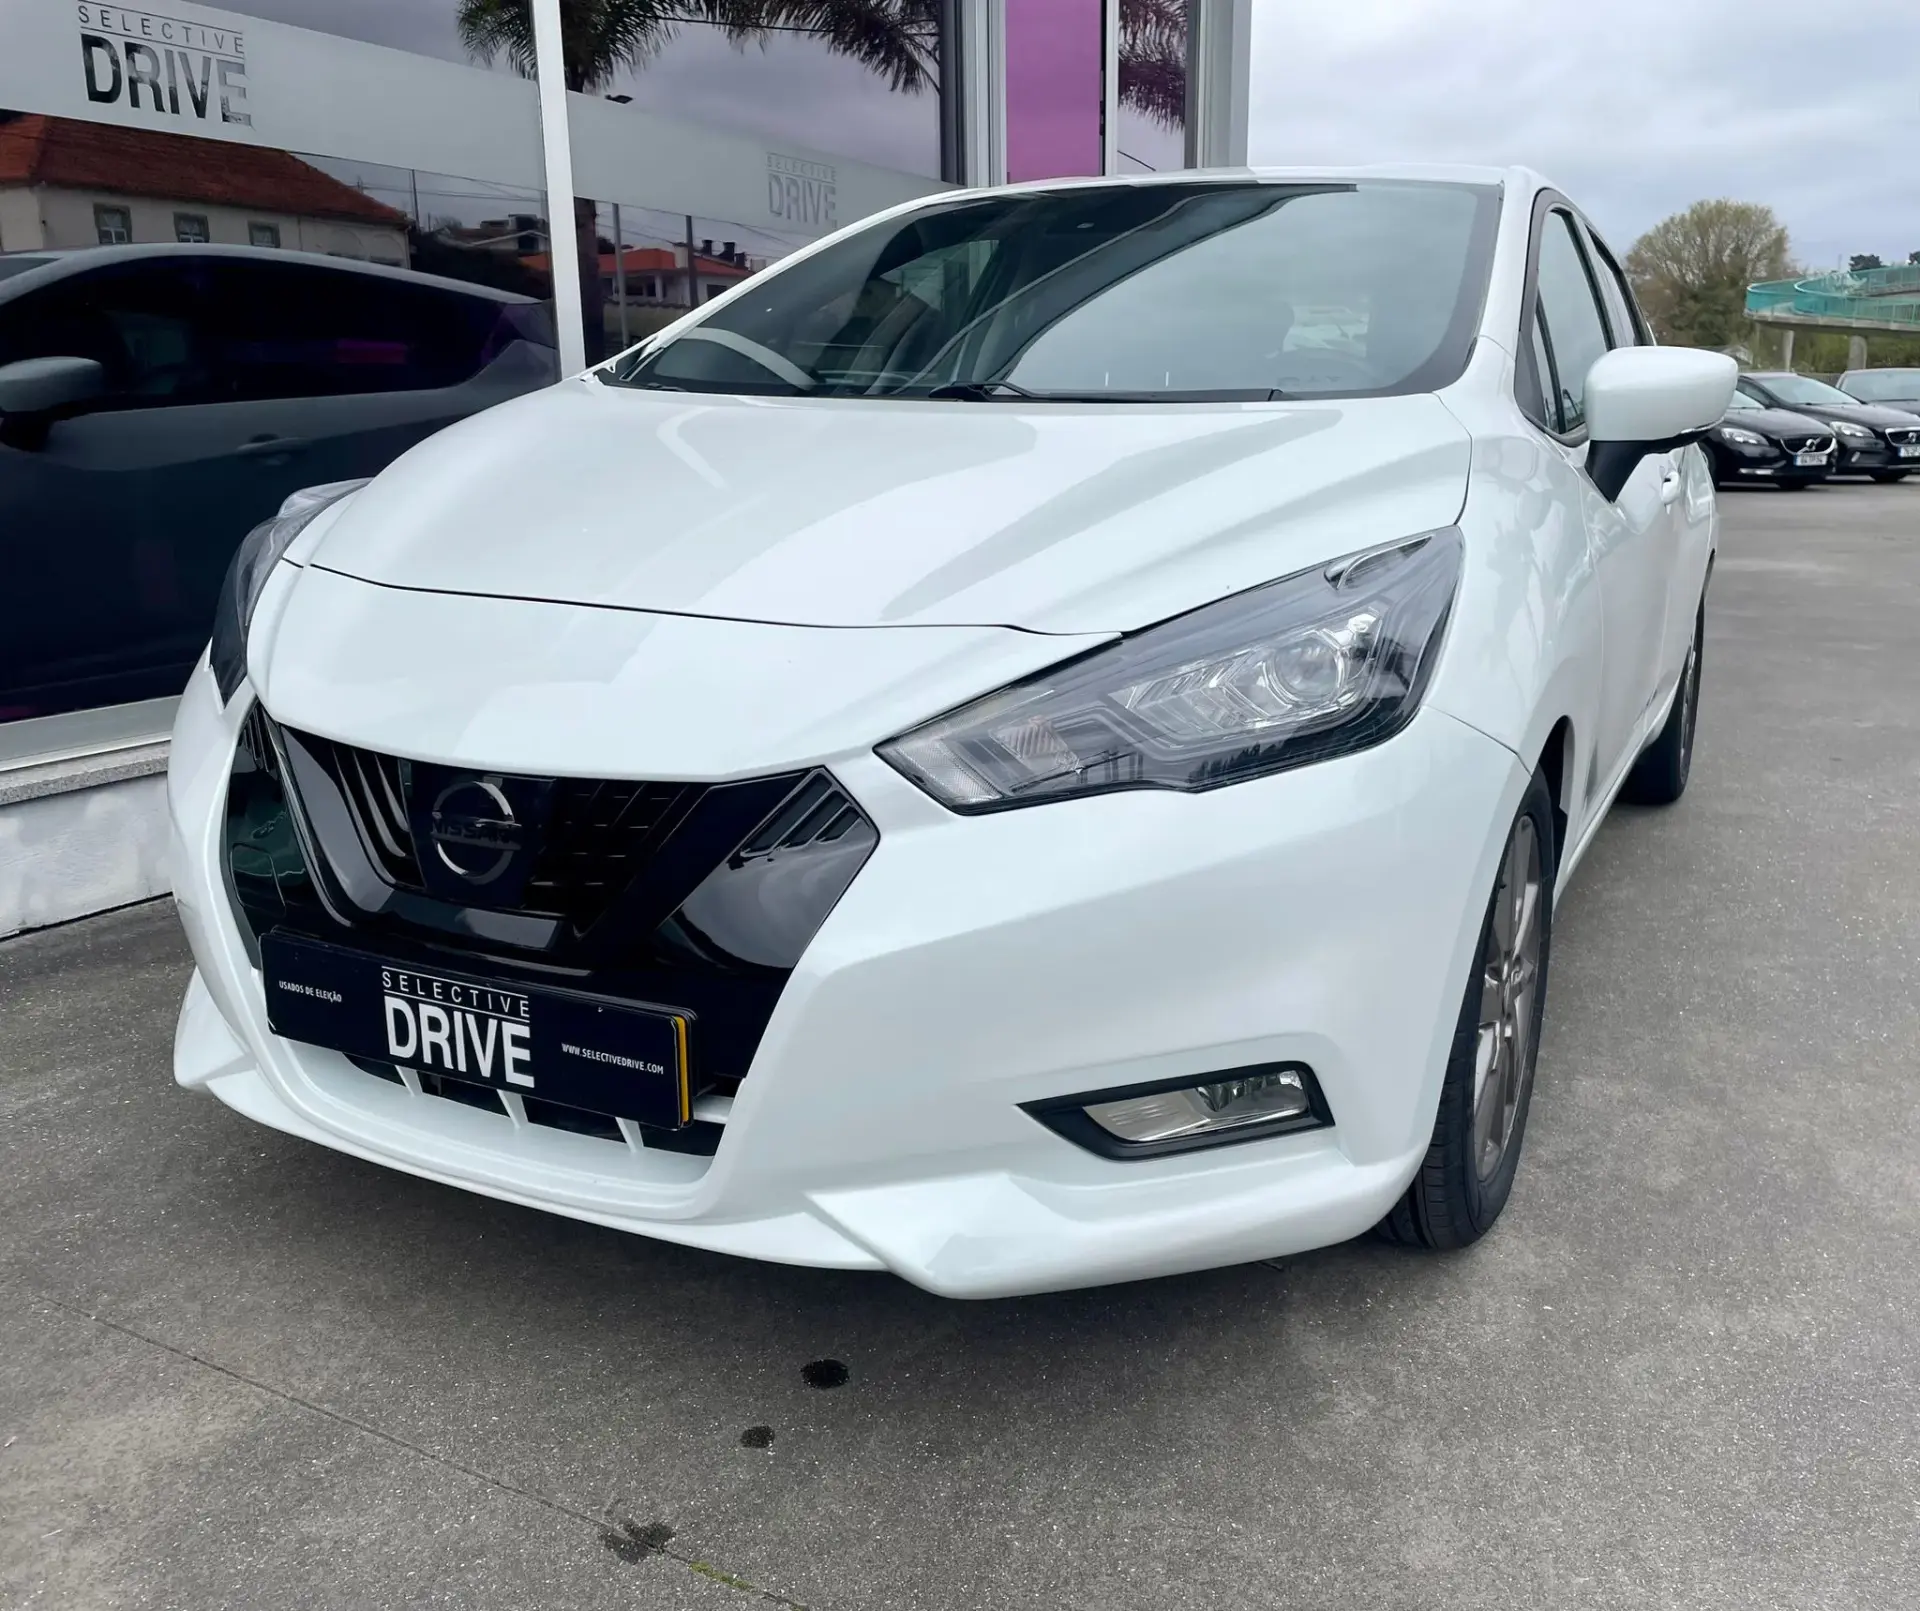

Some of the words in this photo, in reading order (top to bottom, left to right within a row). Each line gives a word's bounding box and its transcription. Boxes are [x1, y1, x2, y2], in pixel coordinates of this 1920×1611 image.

[78, 6, 243, 52] SELECTIVE
[80, 34, 251, 126] DRIVE
[766, 155, 837, 182] SELECTIVE
[768, 173, 838, 228] DRIVE
[278, 980, 304, 994] USADOS
[305, 986, 314, 997] DE
[382, 971, 530, 1018] SELECTIVE
[384, 995, 535, 1088] DRIVE
[561, 1042, 664, 1074] WWW.SELECTIVEDRIVE.COM
